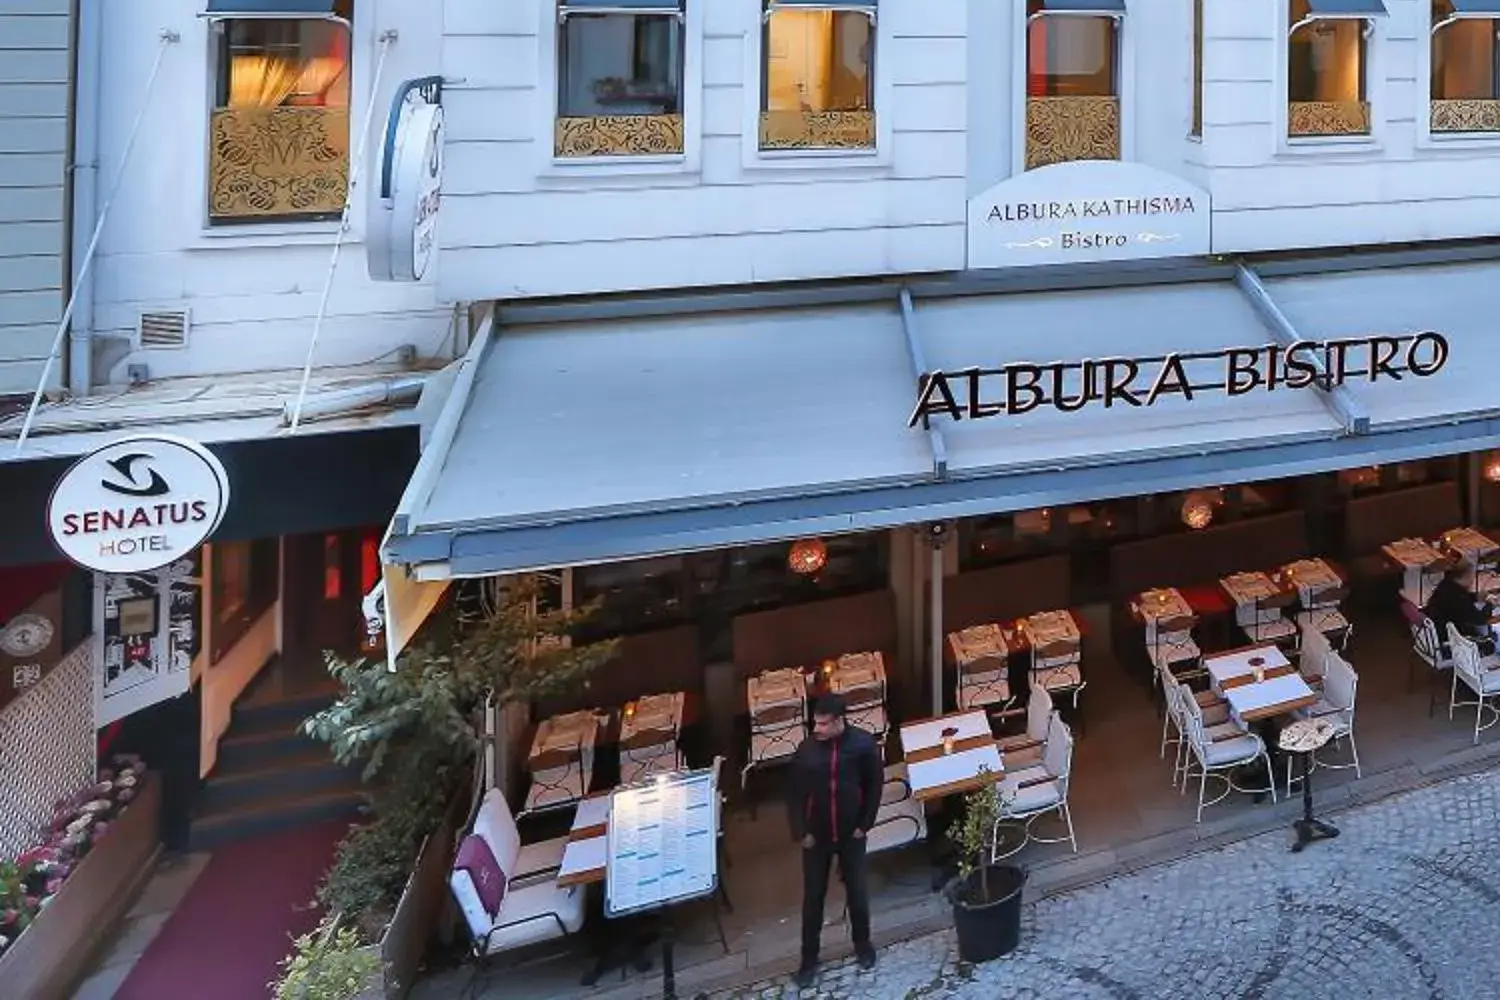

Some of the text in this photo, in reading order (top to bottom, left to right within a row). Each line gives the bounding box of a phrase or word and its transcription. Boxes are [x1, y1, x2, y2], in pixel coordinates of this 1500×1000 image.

[987, 197, 1195, 221] ALBURA KATHISMA
[1061, 231, 1127, 249] Bistro
[908, 331, 1449, 428] ALBURA BISTRO
[62, 500, 208, 535] SENATUS
[100, 534, 174, 556] HOTEL
